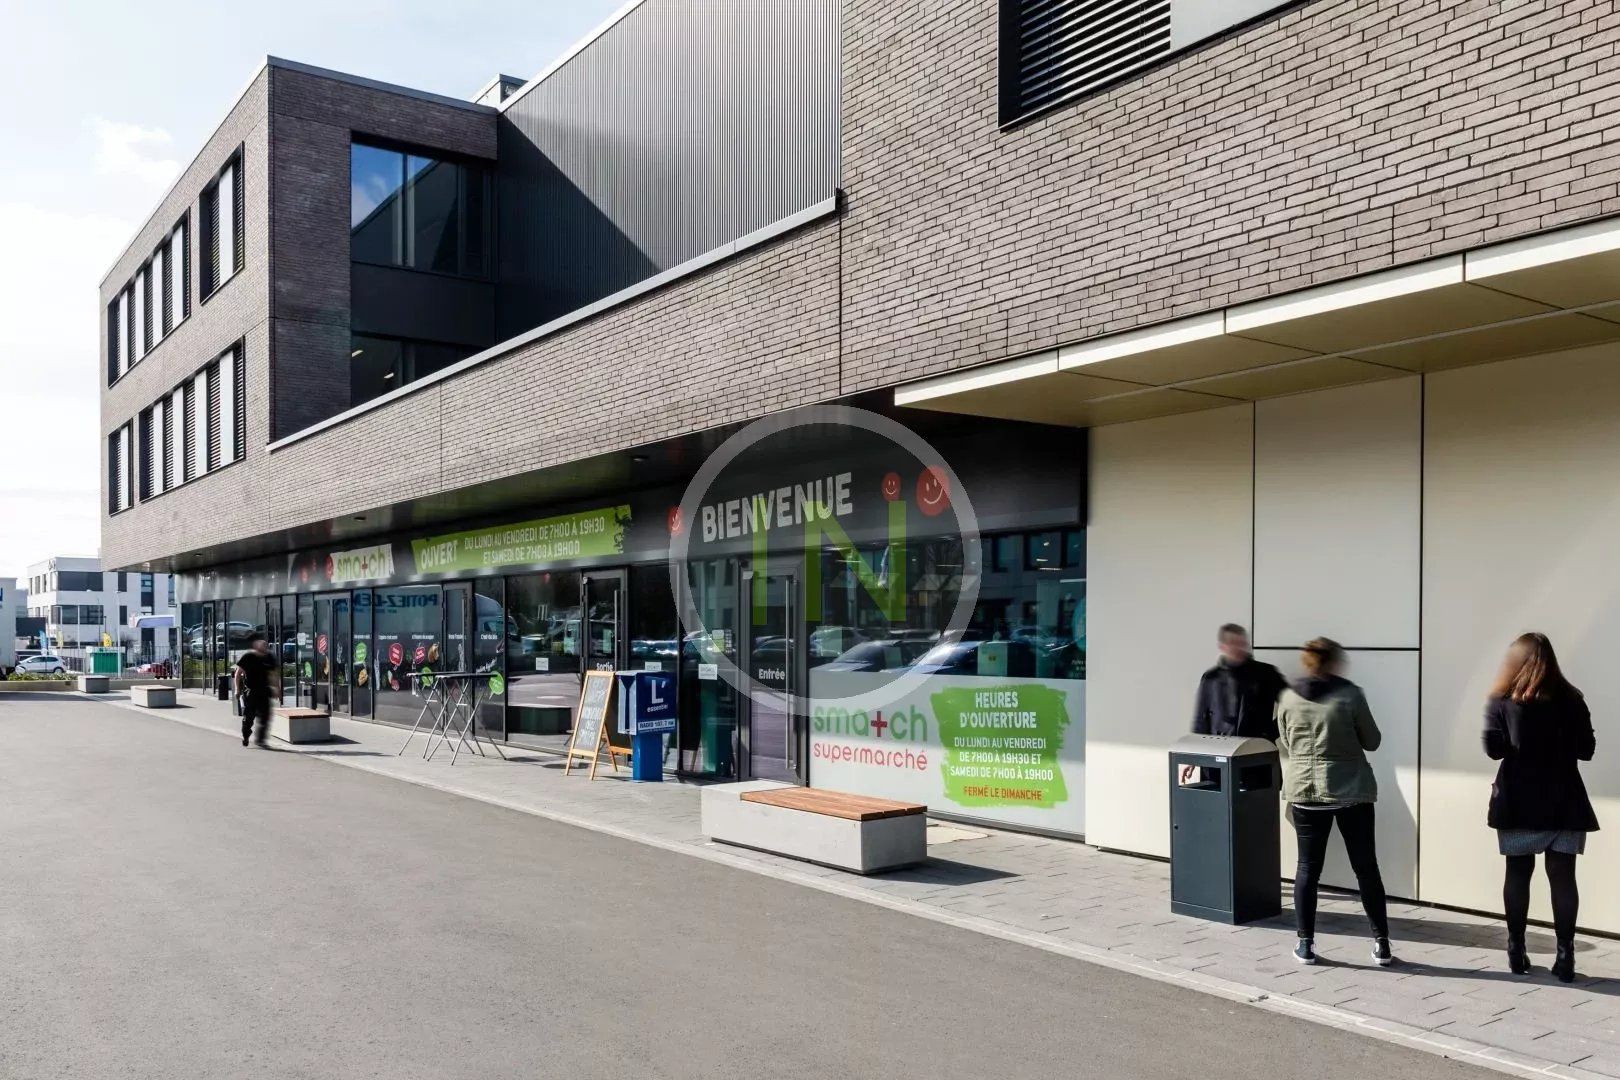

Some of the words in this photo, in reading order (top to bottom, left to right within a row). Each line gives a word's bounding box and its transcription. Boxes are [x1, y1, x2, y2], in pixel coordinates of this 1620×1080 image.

[702, 472, 852, 542] BIENVENUE
[464, 536, 474, 550] DU
[474, 534, 493, 550] LUNDI
[494, 533, 502, 546] AU
[503, 527, 538, 545] VENDREDI
[540, 525, 549, 540] DE
[549, 522, 570, 539] 7H00
[572, 516, 578, 536] À
[580, 516, 604, 535] 19H30
[421, 540, 458, 570] OUVERT
[483, 551, 491, 565] ET
[491, 548, 514, 564] SAMEDI
[515, 546, 525, 560] DE
[527, 544, 547, 560] 7H00
[548, 540, 553, 558] À
[554, 540, 580, 557] 19H00
[596, 661, 613, 672] Sortie
[758, 668, 785, 680] Entrée
[975, 691, 1019, 709] HEURES
[960, 711, 1037, 729] D'OUVERTURE
[954, 736, 965, 748] DU
[966, 737, 991, 748] LUNDI
[992, 738, 1001, 748] AU
[1003, 737, 1047, 749] VENDREDI
[813, 742, 928, 771] supermarché
[959, 751, 970, 763] DE
[971, 752, 993, 763] 7H00
[994, 750, 1001, 763] À
[1002, 752, 1030, 765] 19H30
[1031, 754, 1042, 765] ET
[950, 765, 979, 777] SAMEDI
[980, 766, 991, 778] DE
[993, 767, 1016, 779] 7H00
[1017, 765, 1023, 780] À
[1024, 768, 1053, 781] 19H00
[963, 785, 989, 797] FERMÉ
[990, 788, 1000, 798] LE
[1001, 788, 1042, 800] DIMANCHE
